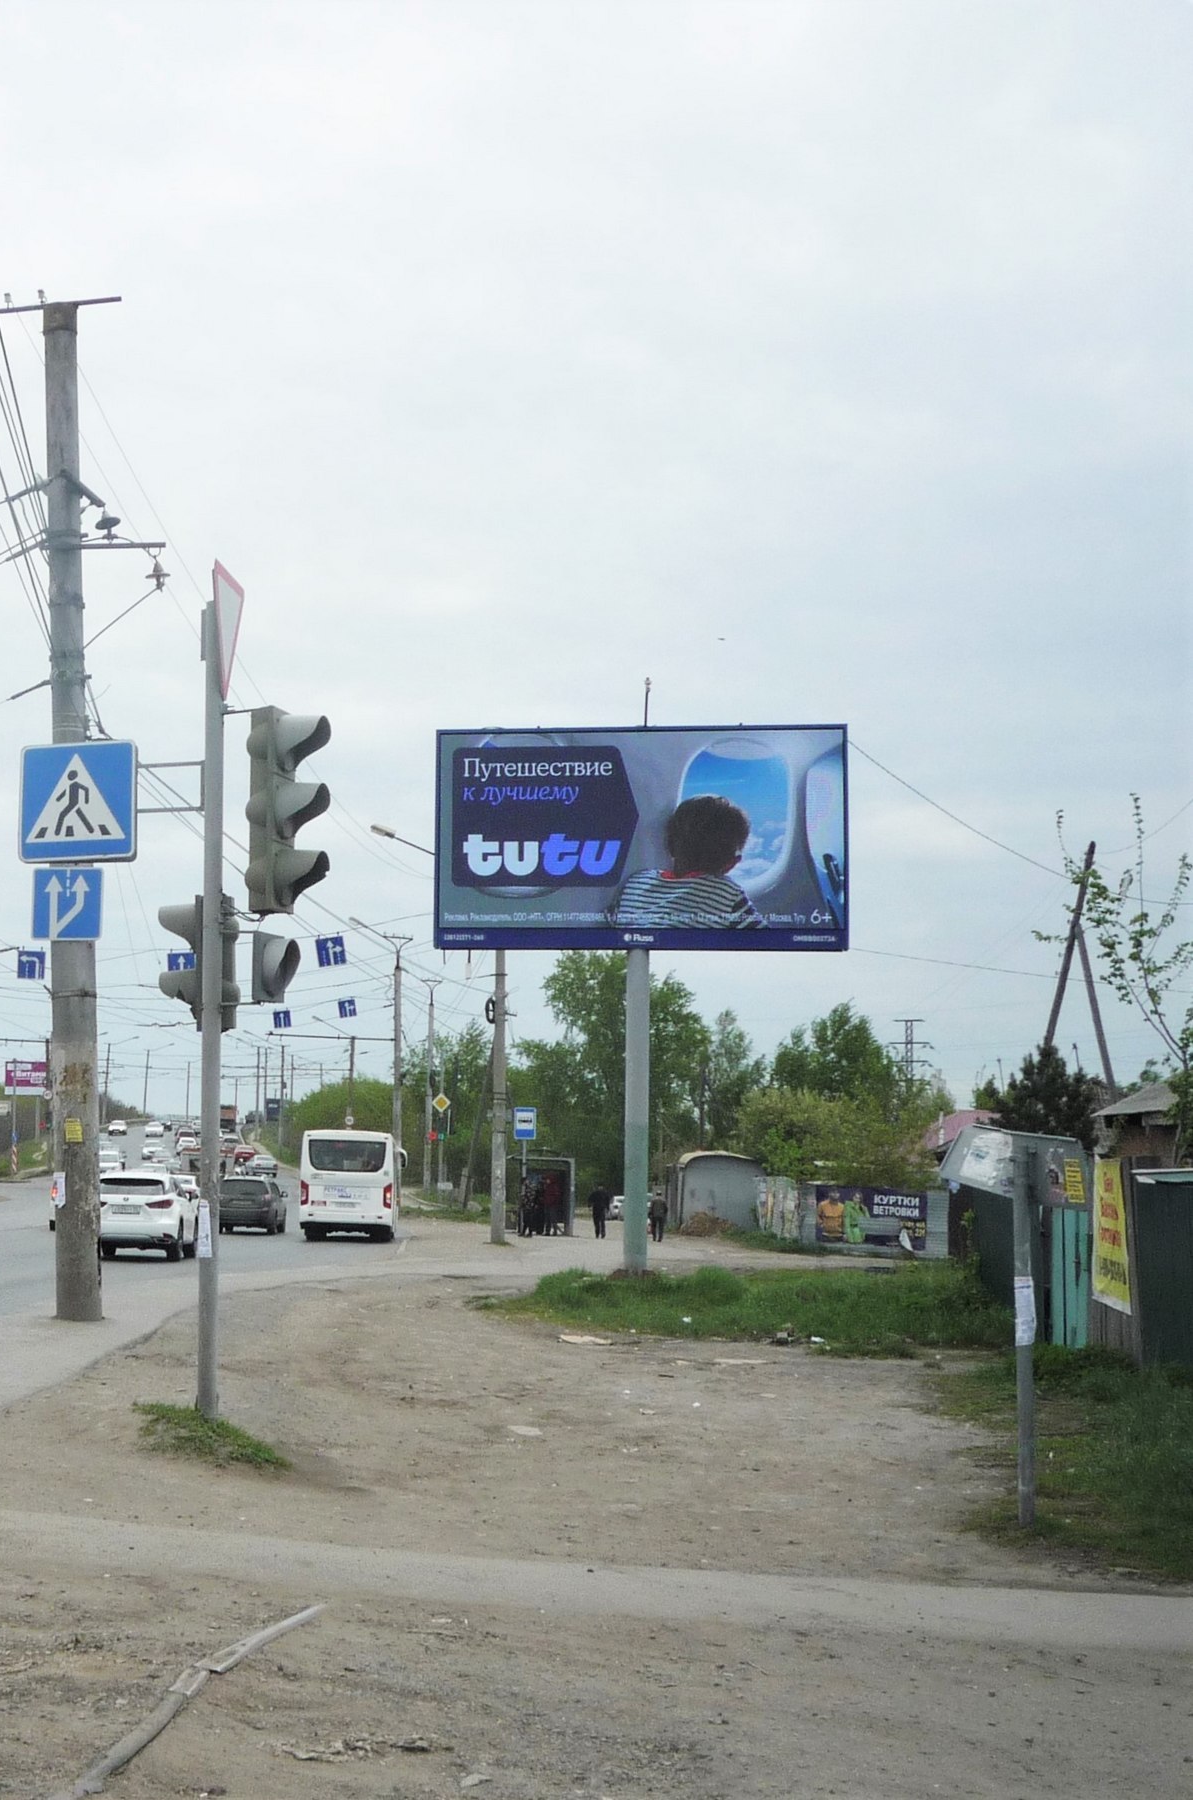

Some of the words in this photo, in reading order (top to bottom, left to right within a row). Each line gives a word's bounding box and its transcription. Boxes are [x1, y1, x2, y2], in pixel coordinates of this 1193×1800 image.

[463, 758, 613, 782] Путешествие
[463, 786, 476, 801] к
[480, 785, 580, 806] лучшему
[462, 833, 622, 877] tutu
[810, 909, 833, 925] 6+
[633, 933, 654, 942] Russ
[873, 1194, 920, 1207] КУРТКИ
[872, 1205, 920, 1217] ВЕТРОВКИ
